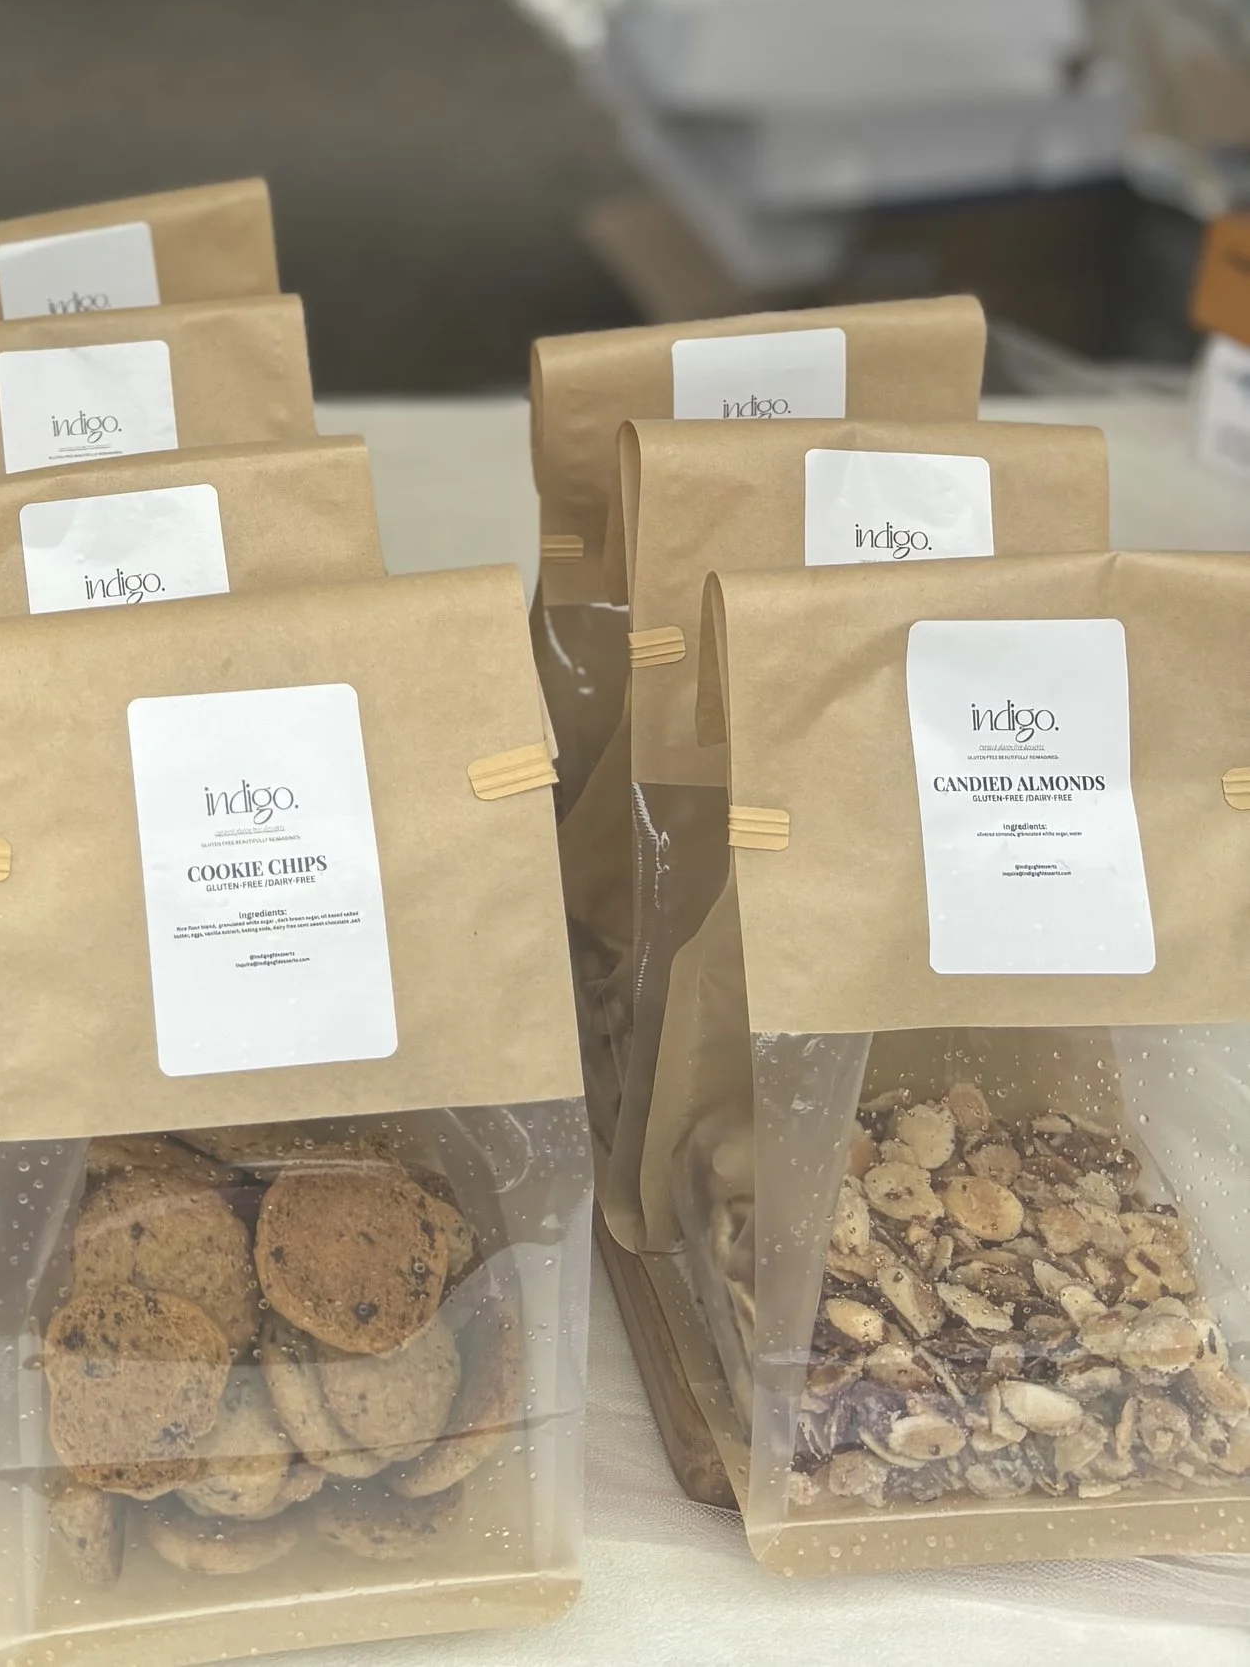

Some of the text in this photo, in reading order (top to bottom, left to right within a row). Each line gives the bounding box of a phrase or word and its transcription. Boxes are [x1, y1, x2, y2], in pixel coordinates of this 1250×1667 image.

[723, 394, 791, 419] indigo.
[52, 410, 122, 443] indigo.
[855, 521, 932, 559] indigo.
[84, 568, 165, 604] indigo.
[971, 699, 1059, 743] indigo.
[933, 775, 1105, 792] CANDIED ALMONDS
[972, 794, 1024, 802] GLUTEN-FREE
[204, 779, 299, 825] indigo.
[187, 854, 328, 883] COOKIE CHIPS
[206, 881, 263, 892] GLUTEN-FREE
